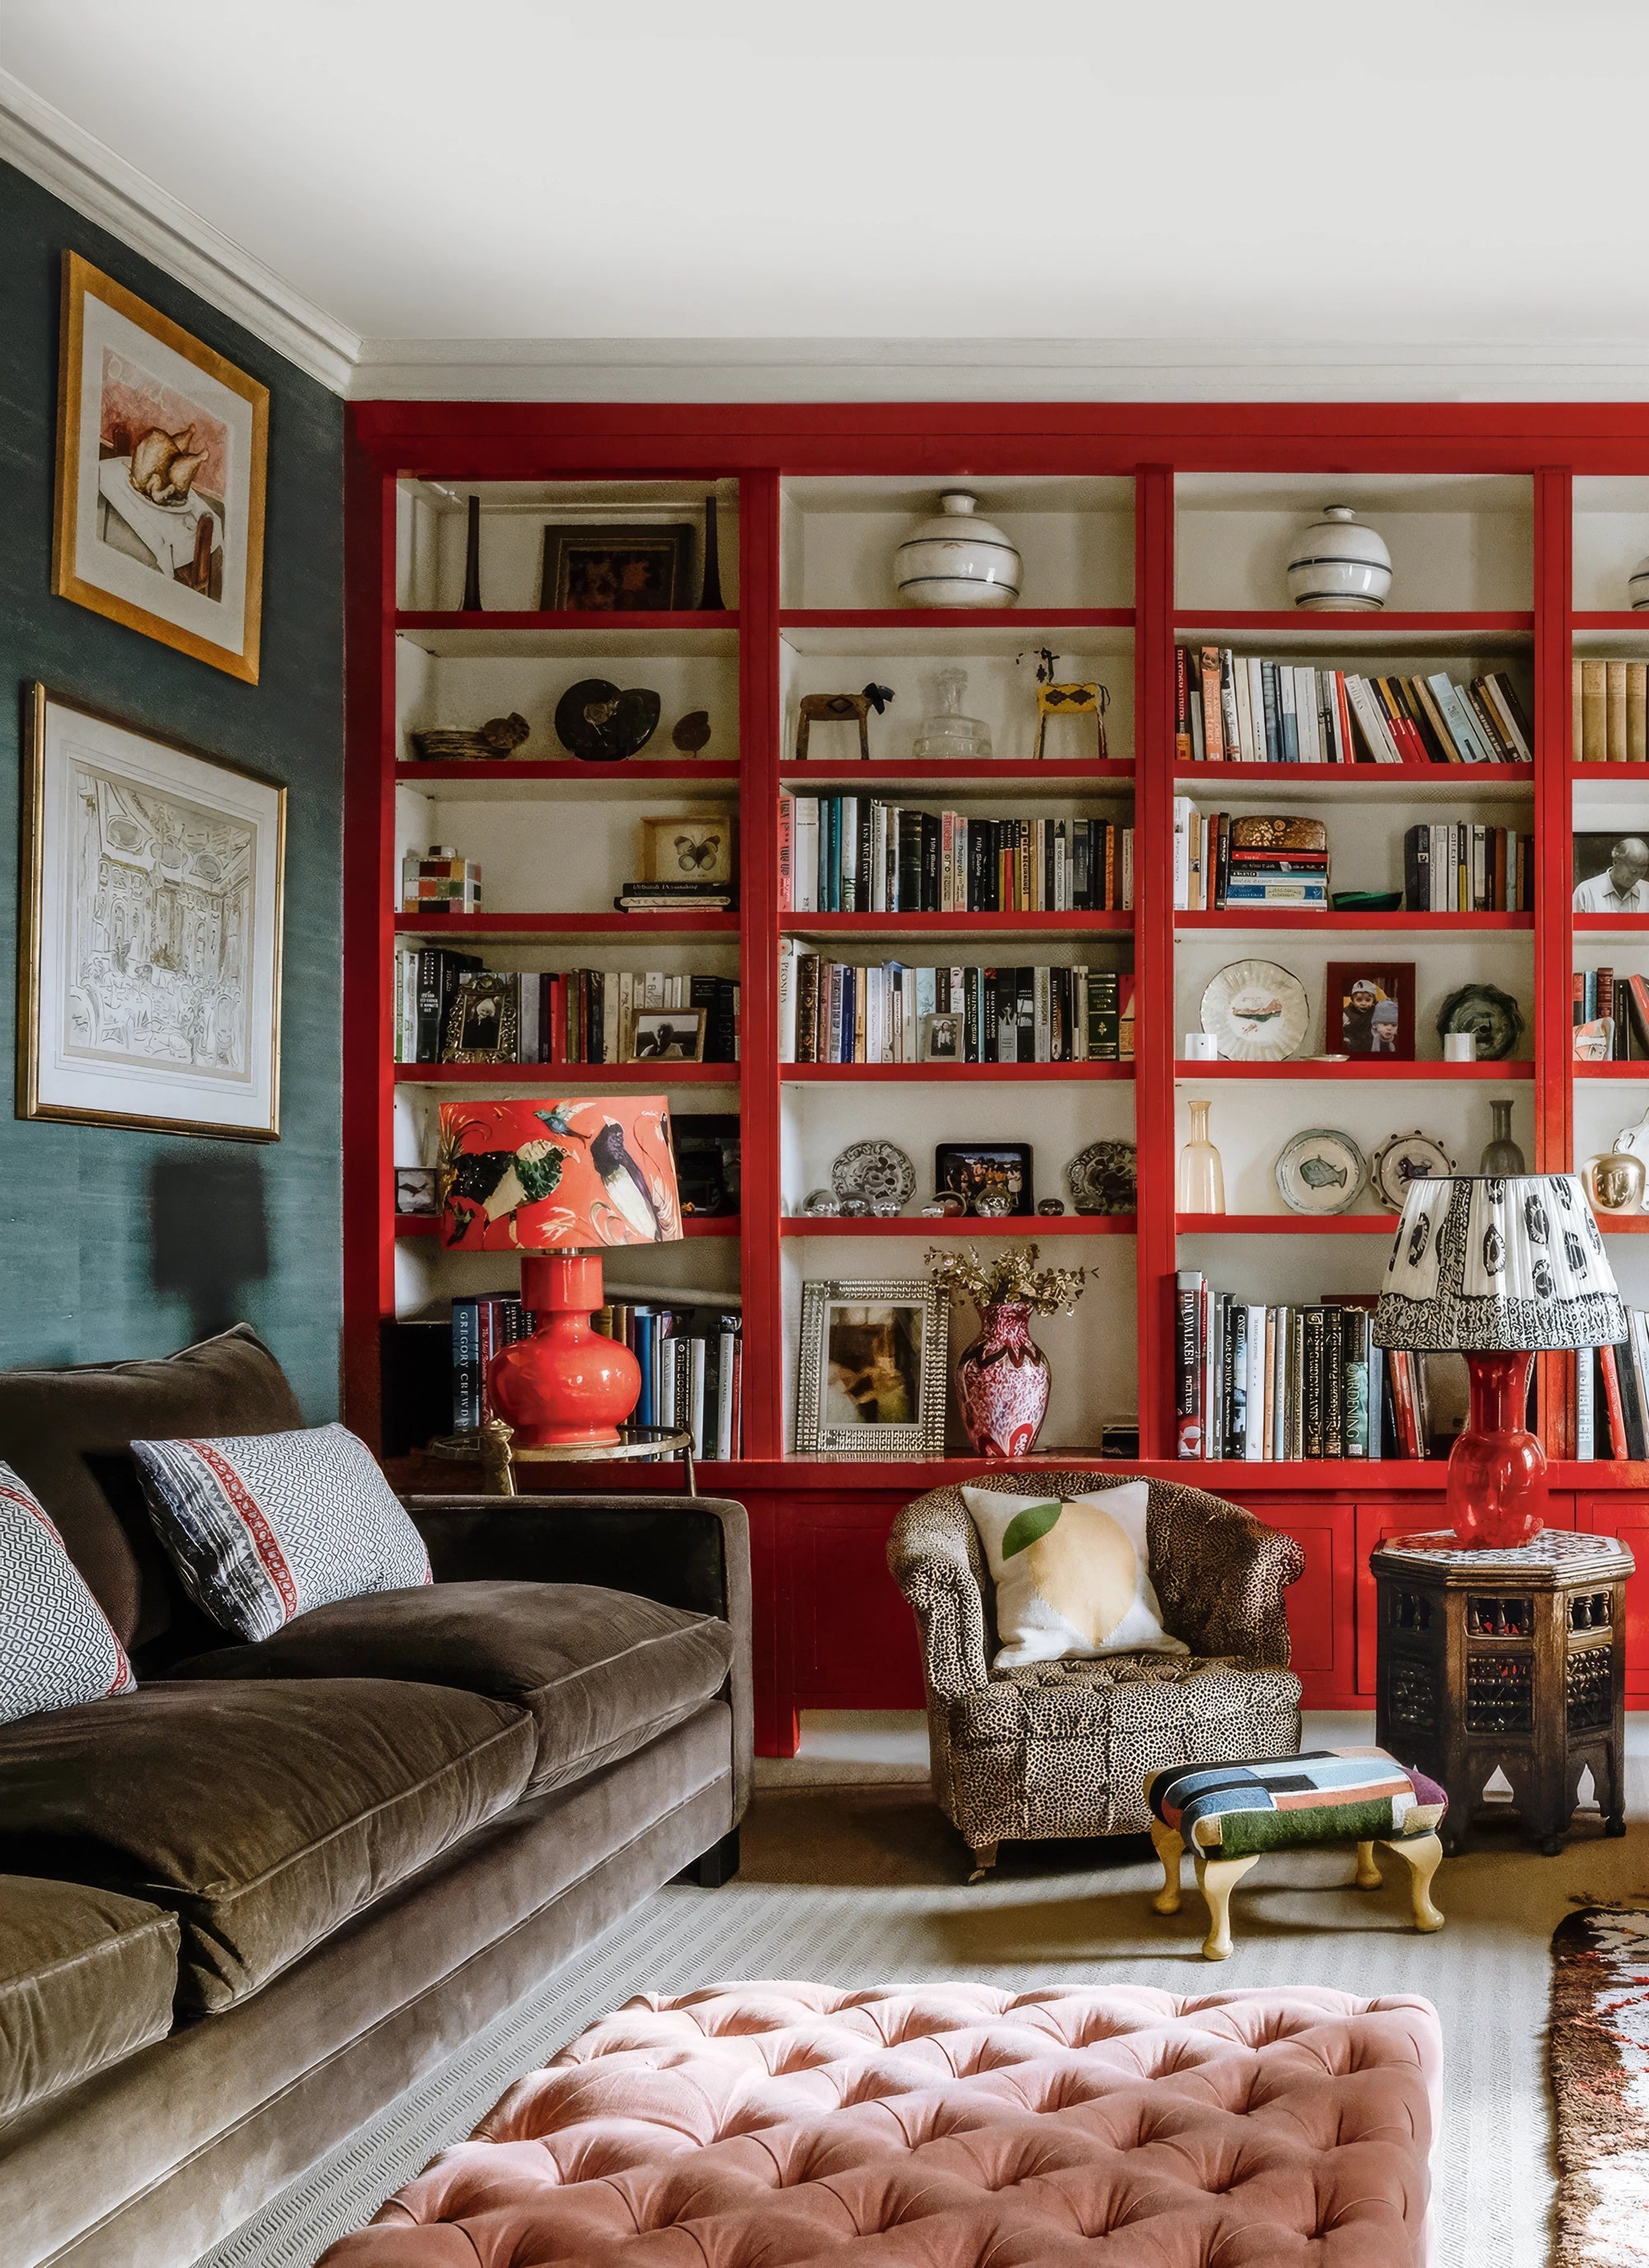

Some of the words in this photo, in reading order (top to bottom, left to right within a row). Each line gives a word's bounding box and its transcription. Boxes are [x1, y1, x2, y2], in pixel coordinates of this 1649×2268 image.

[460, 1311, 469, 1367] GREGORY
[1184, 1314, 1195, 1365] WALKER
[677, 1373, 685, 1399] BOOK
[1346, 1364, 1360, 1437] GARDENING
